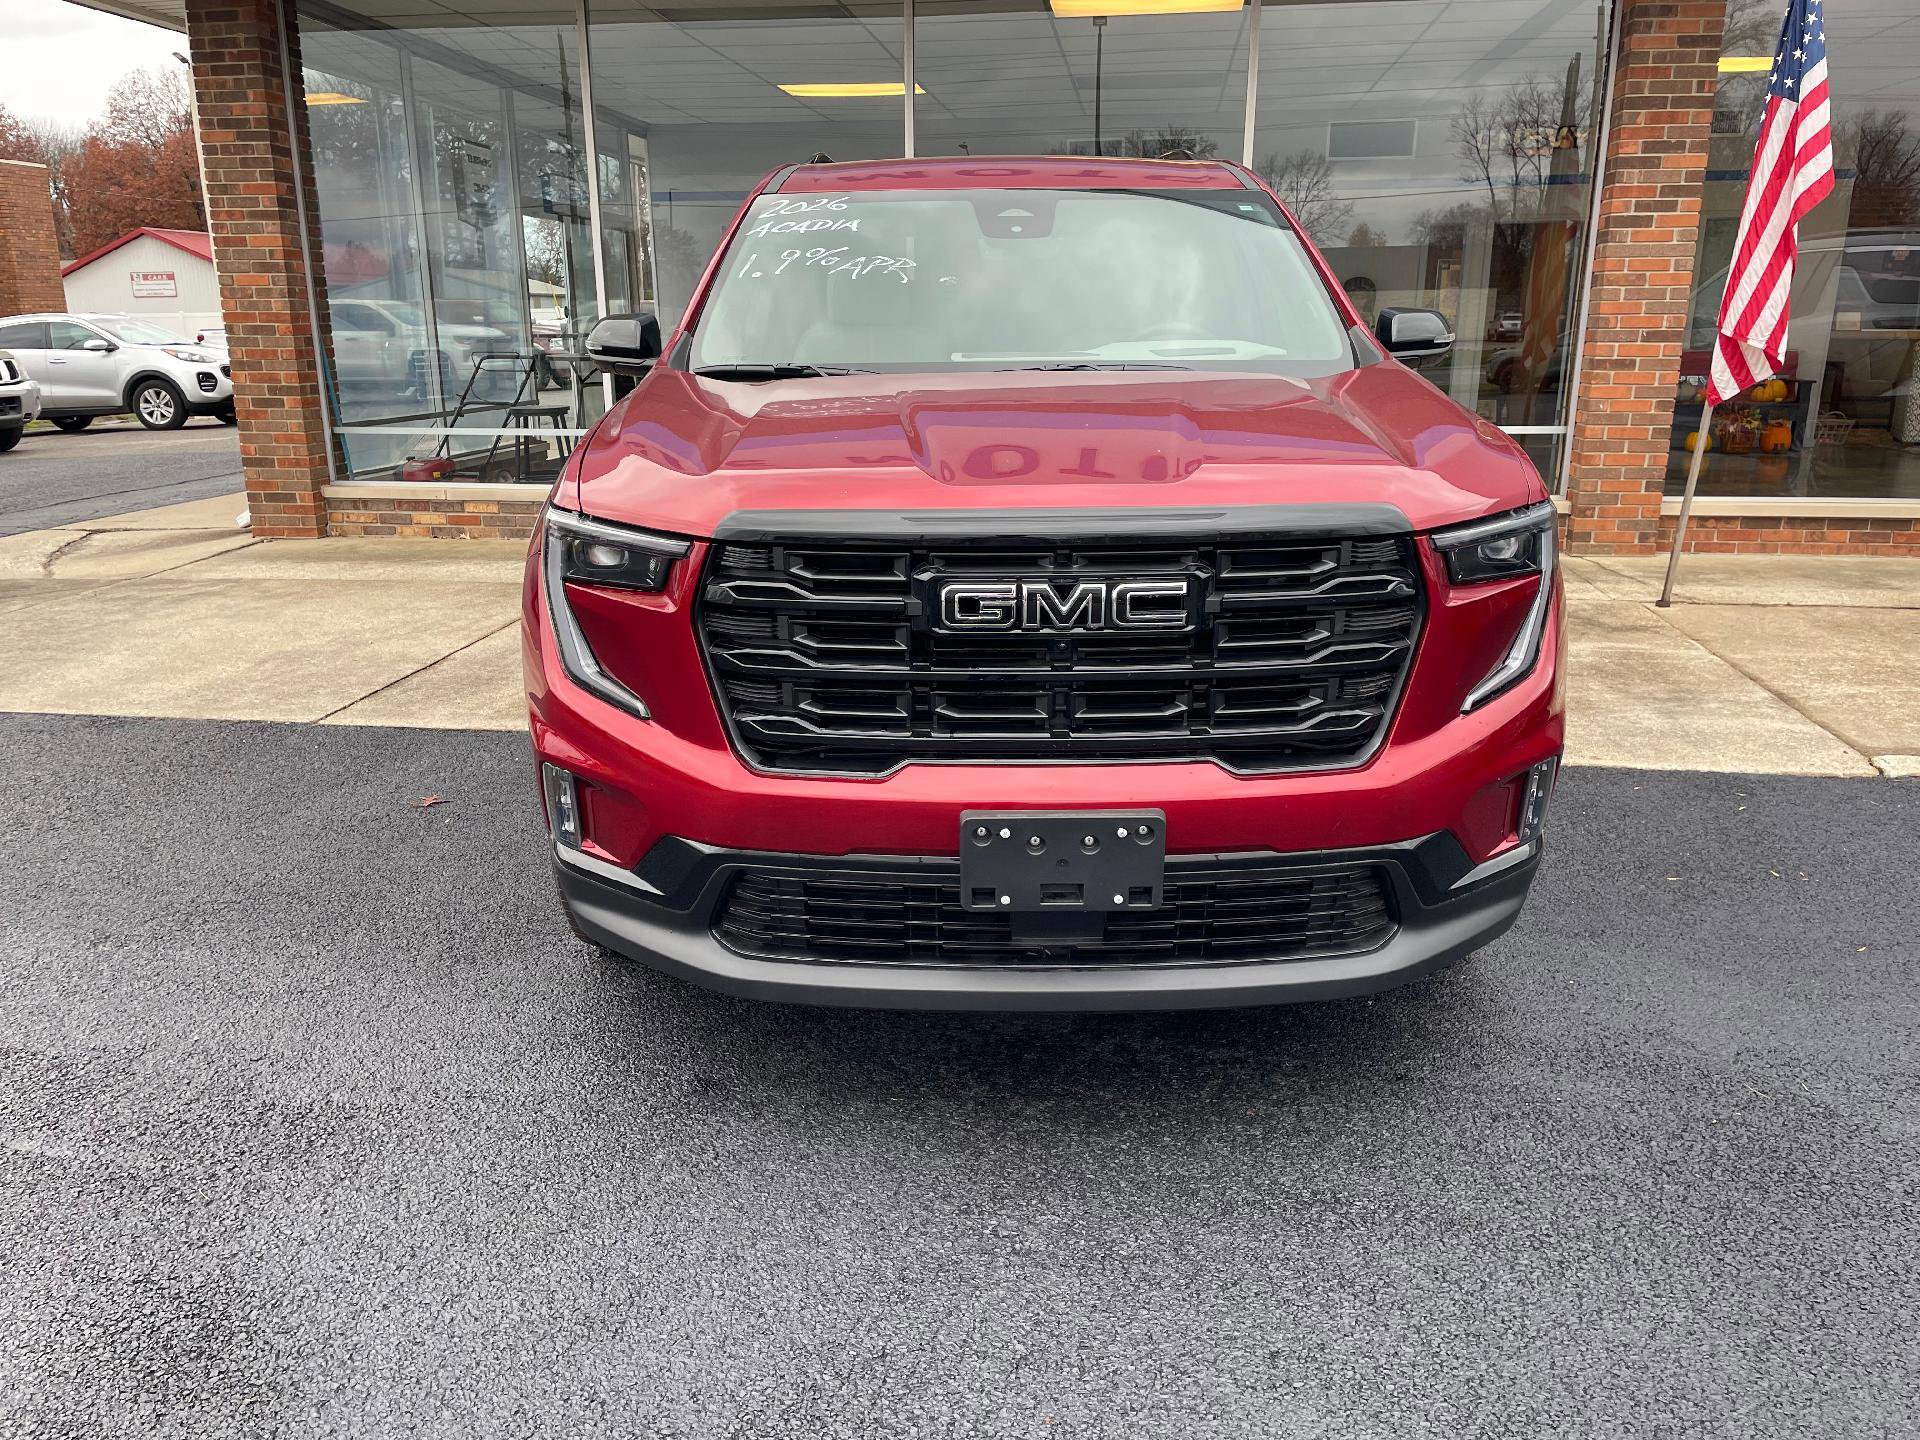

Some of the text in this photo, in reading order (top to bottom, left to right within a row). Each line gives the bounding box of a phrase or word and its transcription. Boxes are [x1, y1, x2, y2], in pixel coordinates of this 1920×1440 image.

[757, 196, 851, 219] 2026
[745, 218, 863, 238] ACADIA
[827, 255, 918, 284] APR
[940, 581, 1189, 630] GMC
